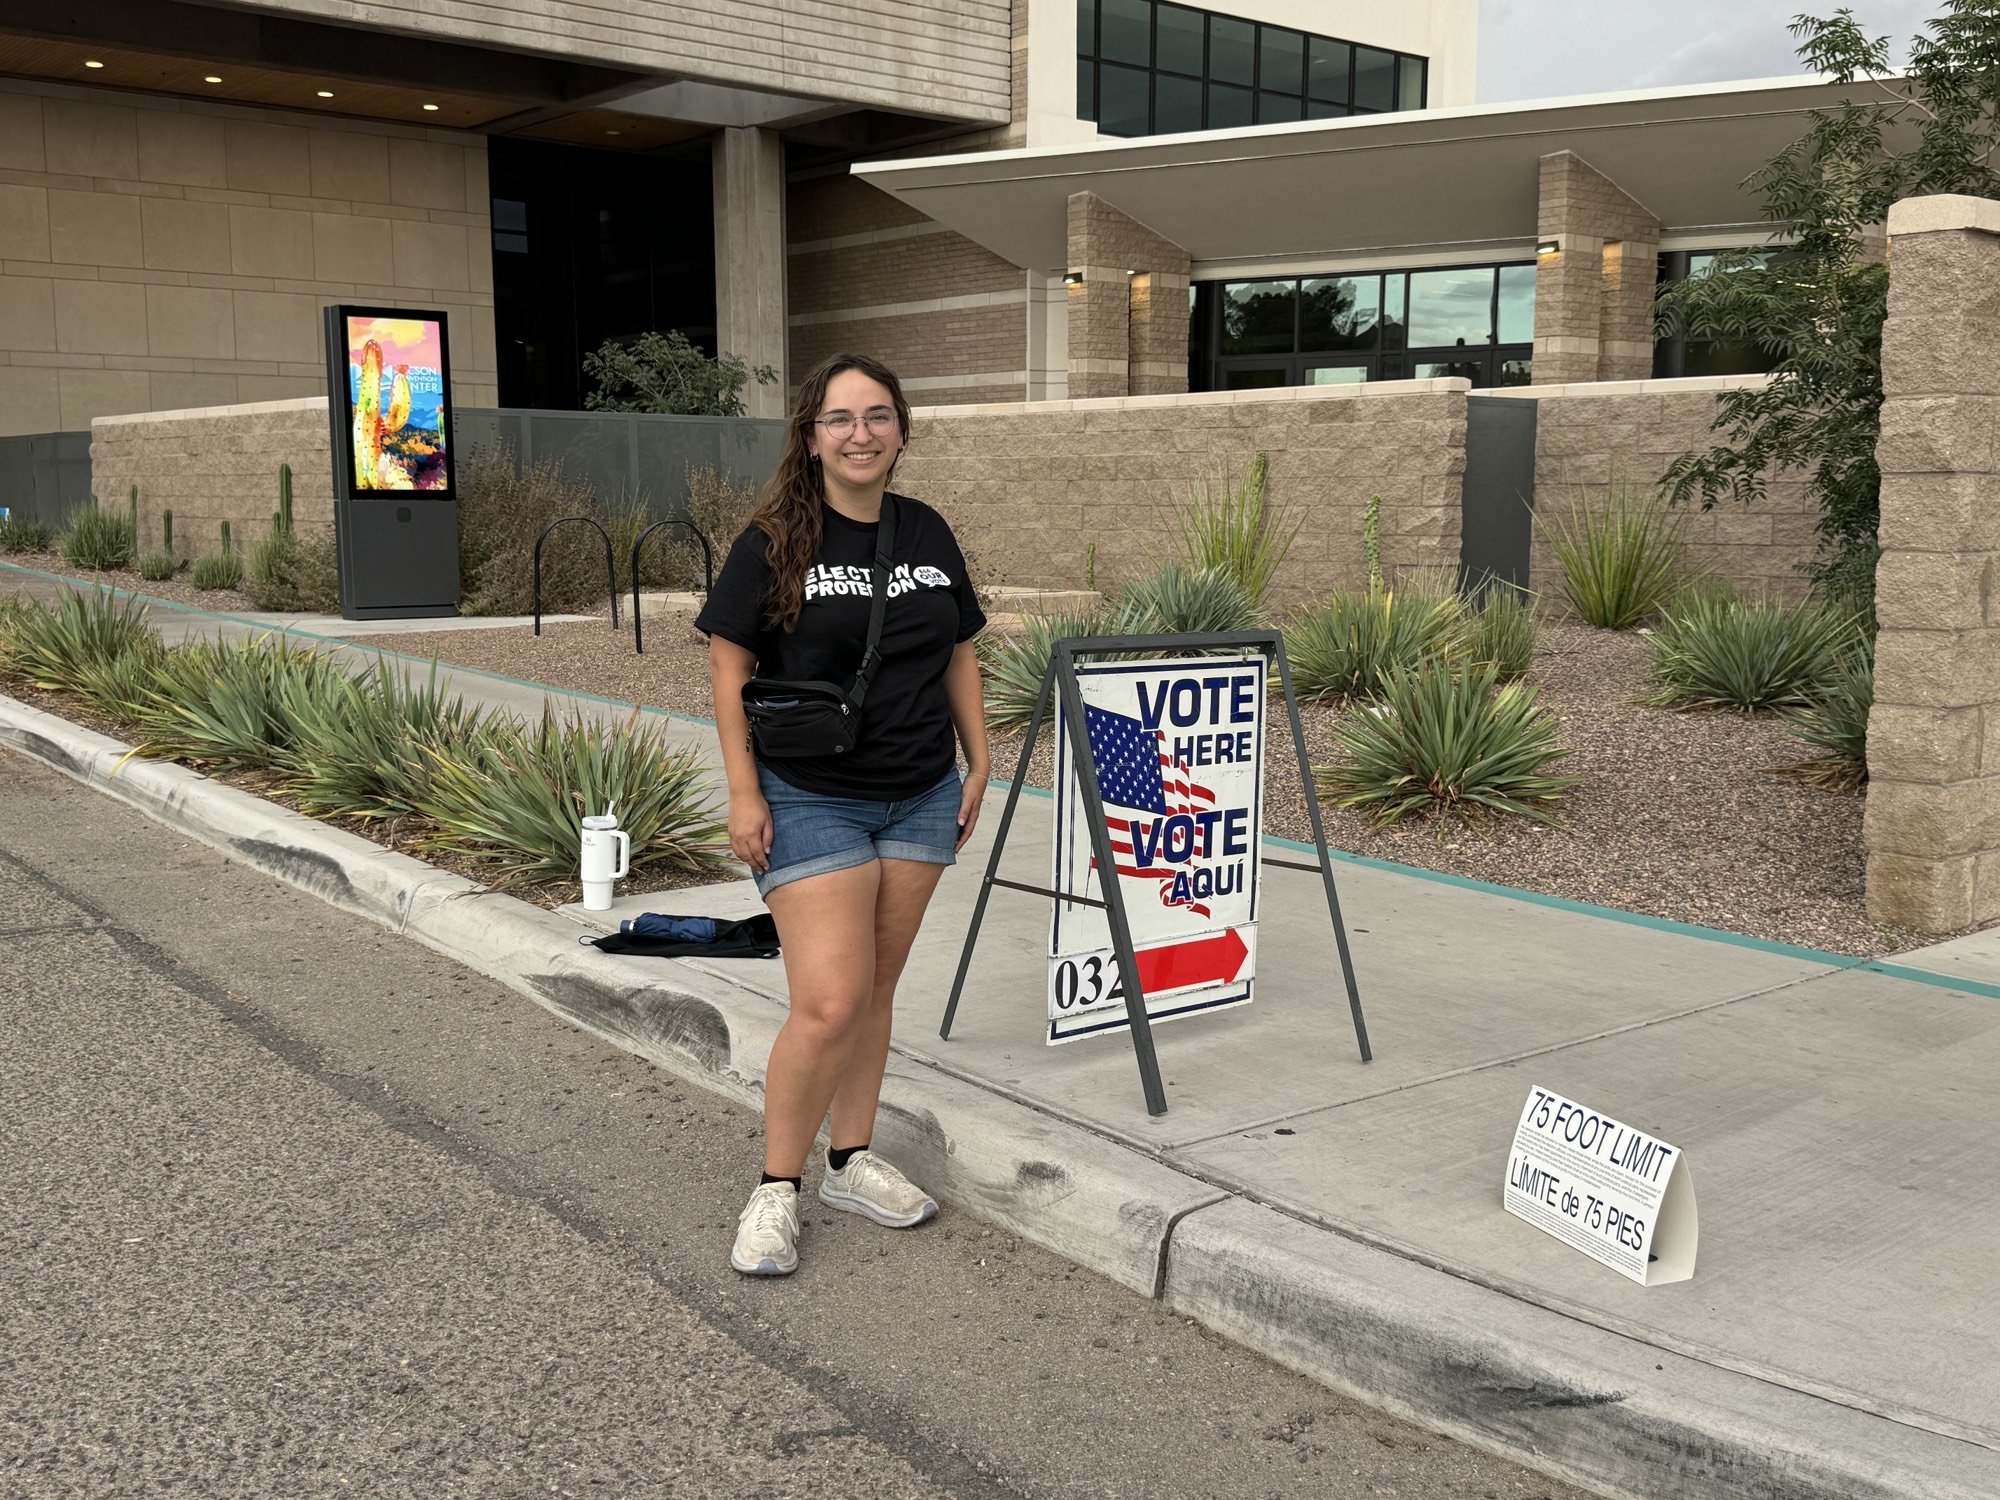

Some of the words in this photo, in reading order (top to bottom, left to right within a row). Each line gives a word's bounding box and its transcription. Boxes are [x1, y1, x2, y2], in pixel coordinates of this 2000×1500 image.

[408, 366, 437, 375] CSON
[411, 383, 438, 392] NTER
[804, 578, 917, 601] PROTEON
[805, 563, 909, 585] ELECTN
[919, 571, 943, 580] OUR
[1135, 675, 1255, 730] VOTE
[1173, 731, 1253, 769] HERE
[1129, 807, 1249, 868] VOTE
[1169, 858, 1245, 904] AQUÍ
[1527, 1091, 1556, 1129] 75
[1551, 1102, 1615, 1155] FOOT
[1609, 1128, 1673, 1182] LIMIT
[1510, 1155, 1561, 1208] LÍMITE
[1561, 1186, 1580, 1218] de
[1583, 1195, 1604, 1230] 75
[1604, 1206, 1646, 1251] PIES
